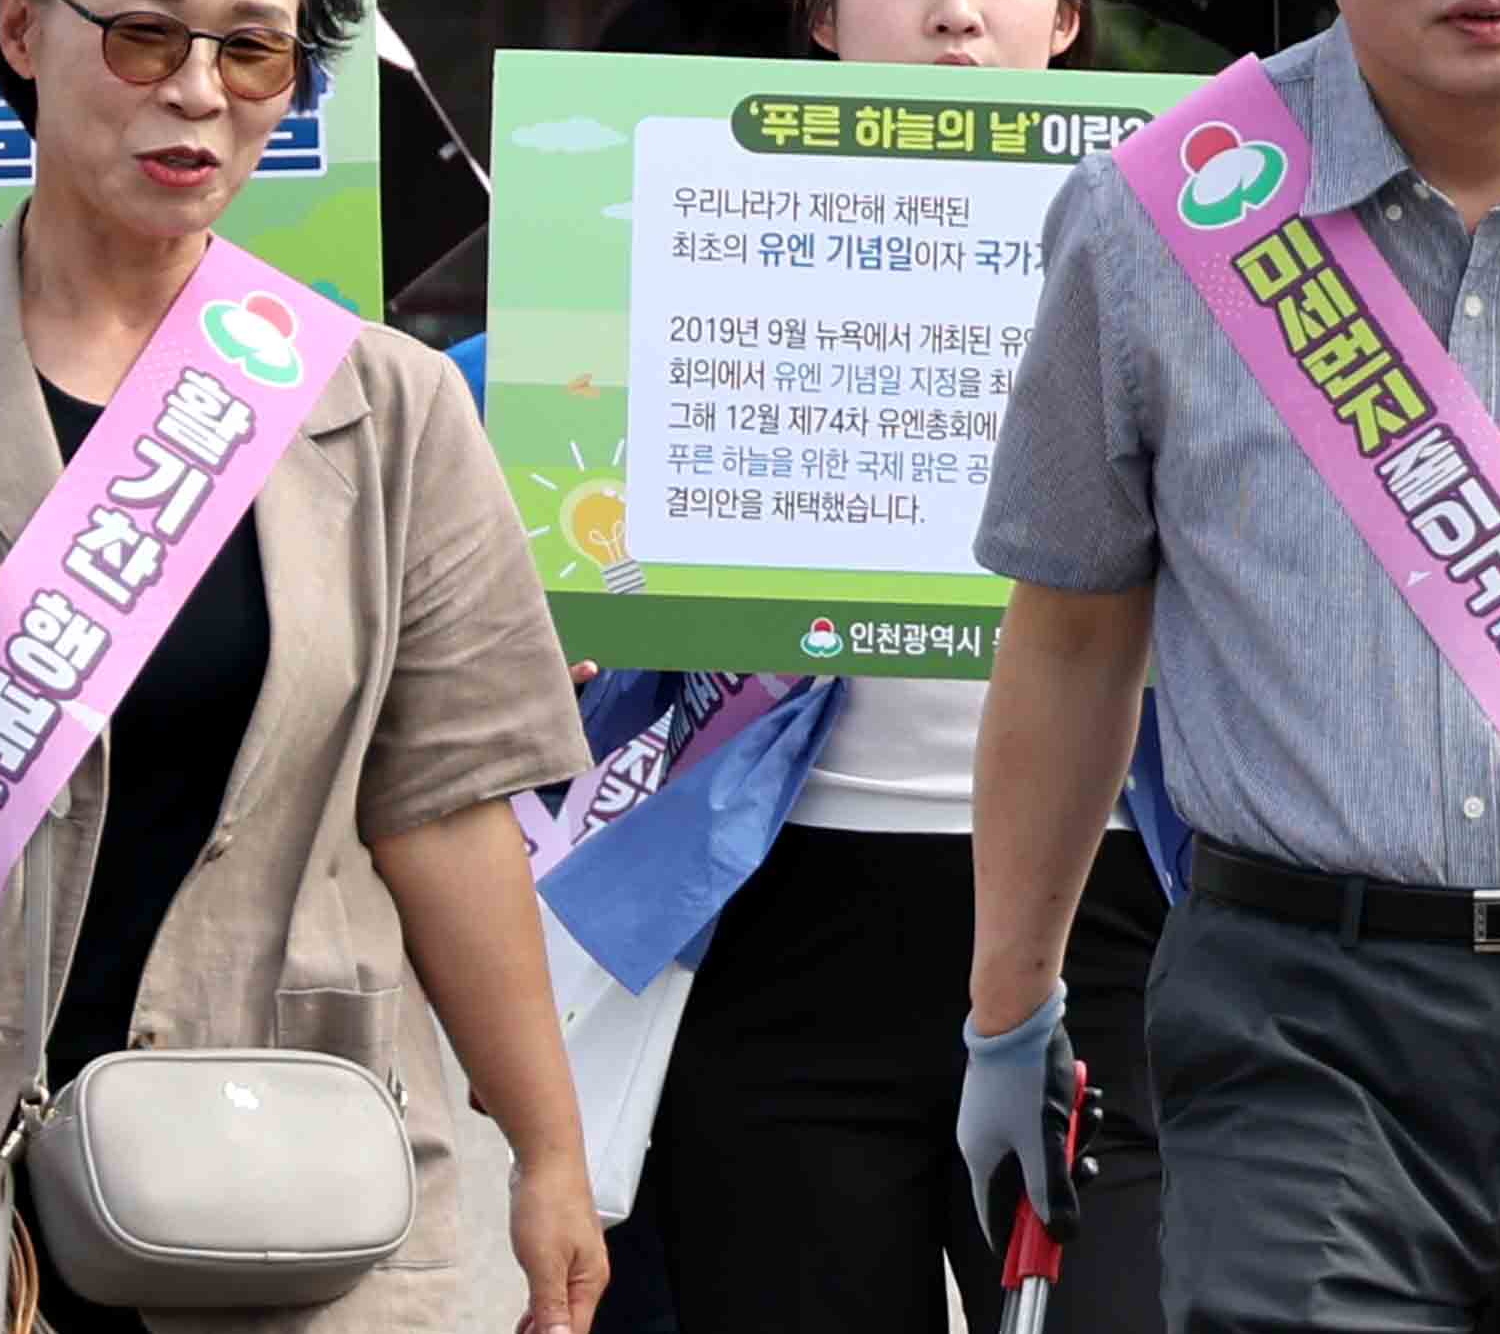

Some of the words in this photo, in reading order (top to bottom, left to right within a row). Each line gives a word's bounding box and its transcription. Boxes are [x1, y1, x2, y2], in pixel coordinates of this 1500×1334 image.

[750, 99, 842, 149] ‘푸른
[856, 107, 976, 153] 하늘의
[673, 188, 801, 223] 우리나라가
[808, 192, 886, 226] 제안해
[894, 195, 971, 229] 채택된
[672, 231, 749, 266] 최초의
[758, 232, 816, 269] 유엔
[825, 234, 966, 273] 기념일이자
[669, 316, 760, 349] 2019년
[768, 319, 808, 351] 9월
[815, 320, 912, 355] 뉴욕에서
[918, 323, 992, 356] 개최된
[1231, 214, 1438, 459] 미세먼지
[668, 359, 765, 392] 회의에서
[773, 361, 823, 394] 유엔
[830, 363, 901, 397] 기념일
[910, 364, 982, 399] 지정을
[668, 401, 718, 434] 그해
[727, 403, 781, 436] 12월
[788, 403, 870, 438] 제74차
[877, 407, 999, 444] 유엔총회에
[667, 442, 714, 479] 푸른
[722, 444, 794, 481] 하늘을
[800, 446, 851, 483] 위한
[856, 448, 905, 484] 국제
[911, 449, 962, 486] 맑은
[60, 366, 255, 612] 활기찬
[666, 486, 763, 522] 결의안을
[771, 490, 928, 526] 채택했습니다.
[849, 620, 982, 657] 인천광역시
